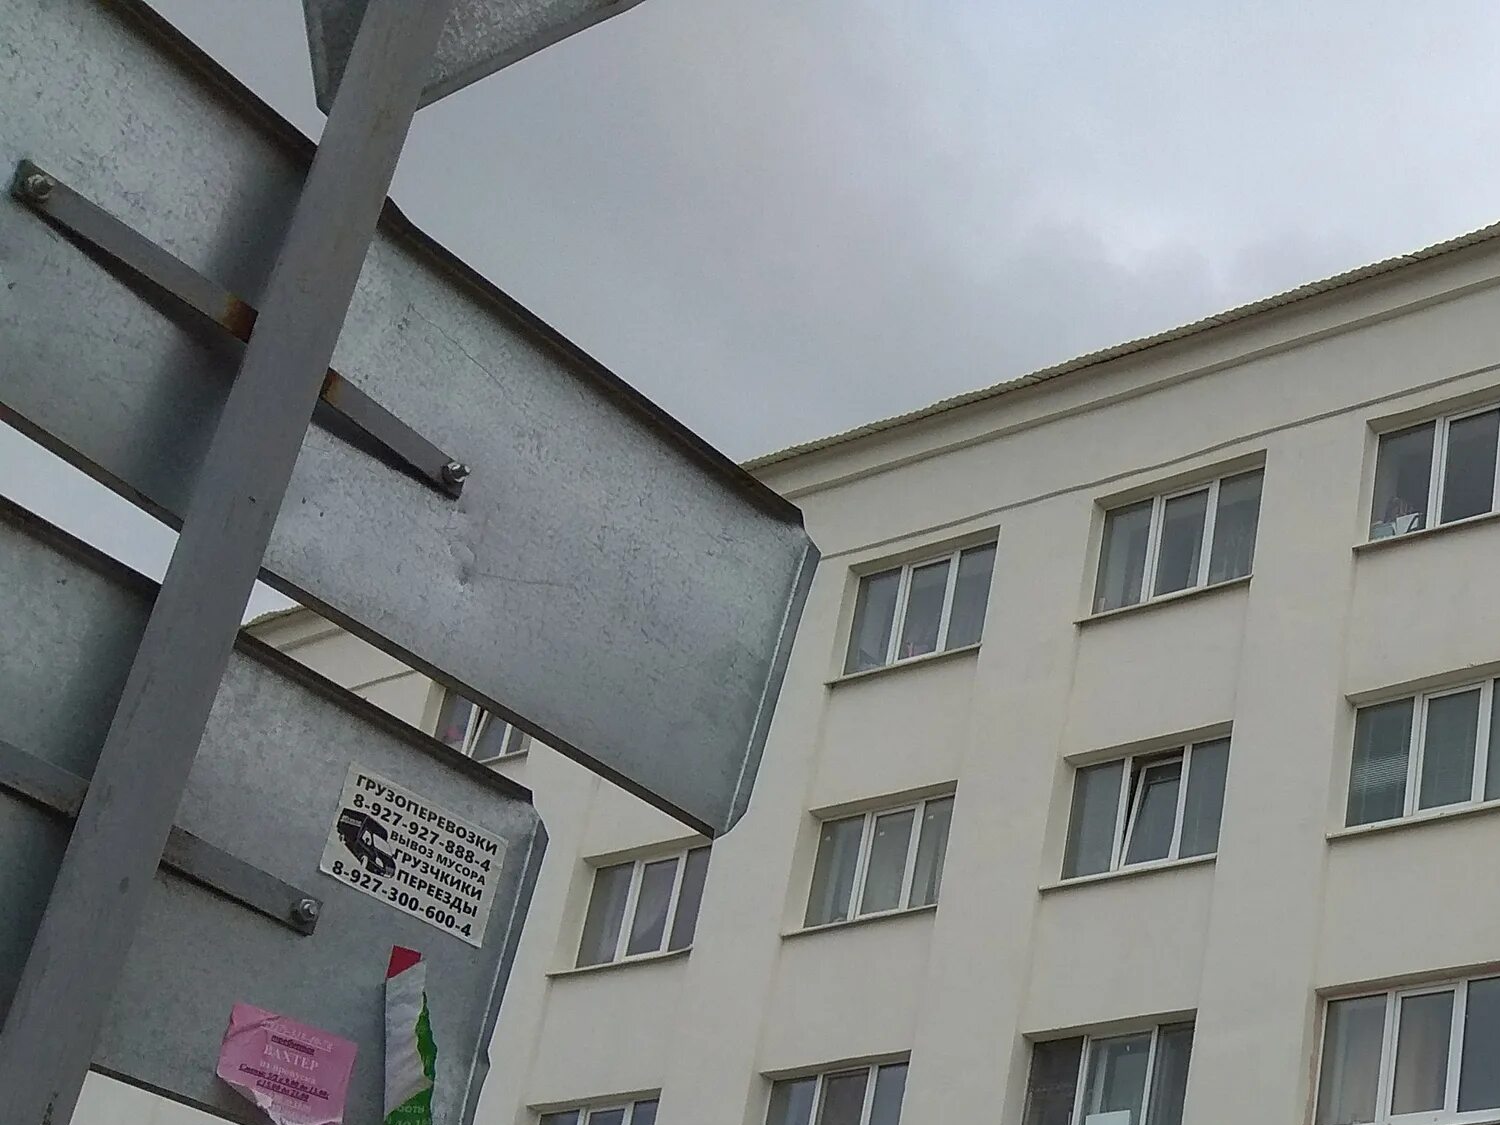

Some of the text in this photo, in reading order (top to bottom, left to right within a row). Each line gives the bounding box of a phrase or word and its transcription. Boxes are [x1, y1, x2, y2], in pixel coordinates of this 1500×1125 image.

[353, 793, 491, 872] 8-927-927-888-4
[356, 774, 498, 856] ГРУЗОПЕРЕВОЗКИ
[390, 830, 486, 885] ВЫВОЗ МУСОРА
[397, 869, 478, 917] ПЕРЕЕЗДЫ
[332, 860, 472, 938] 8-927-300-600-4
